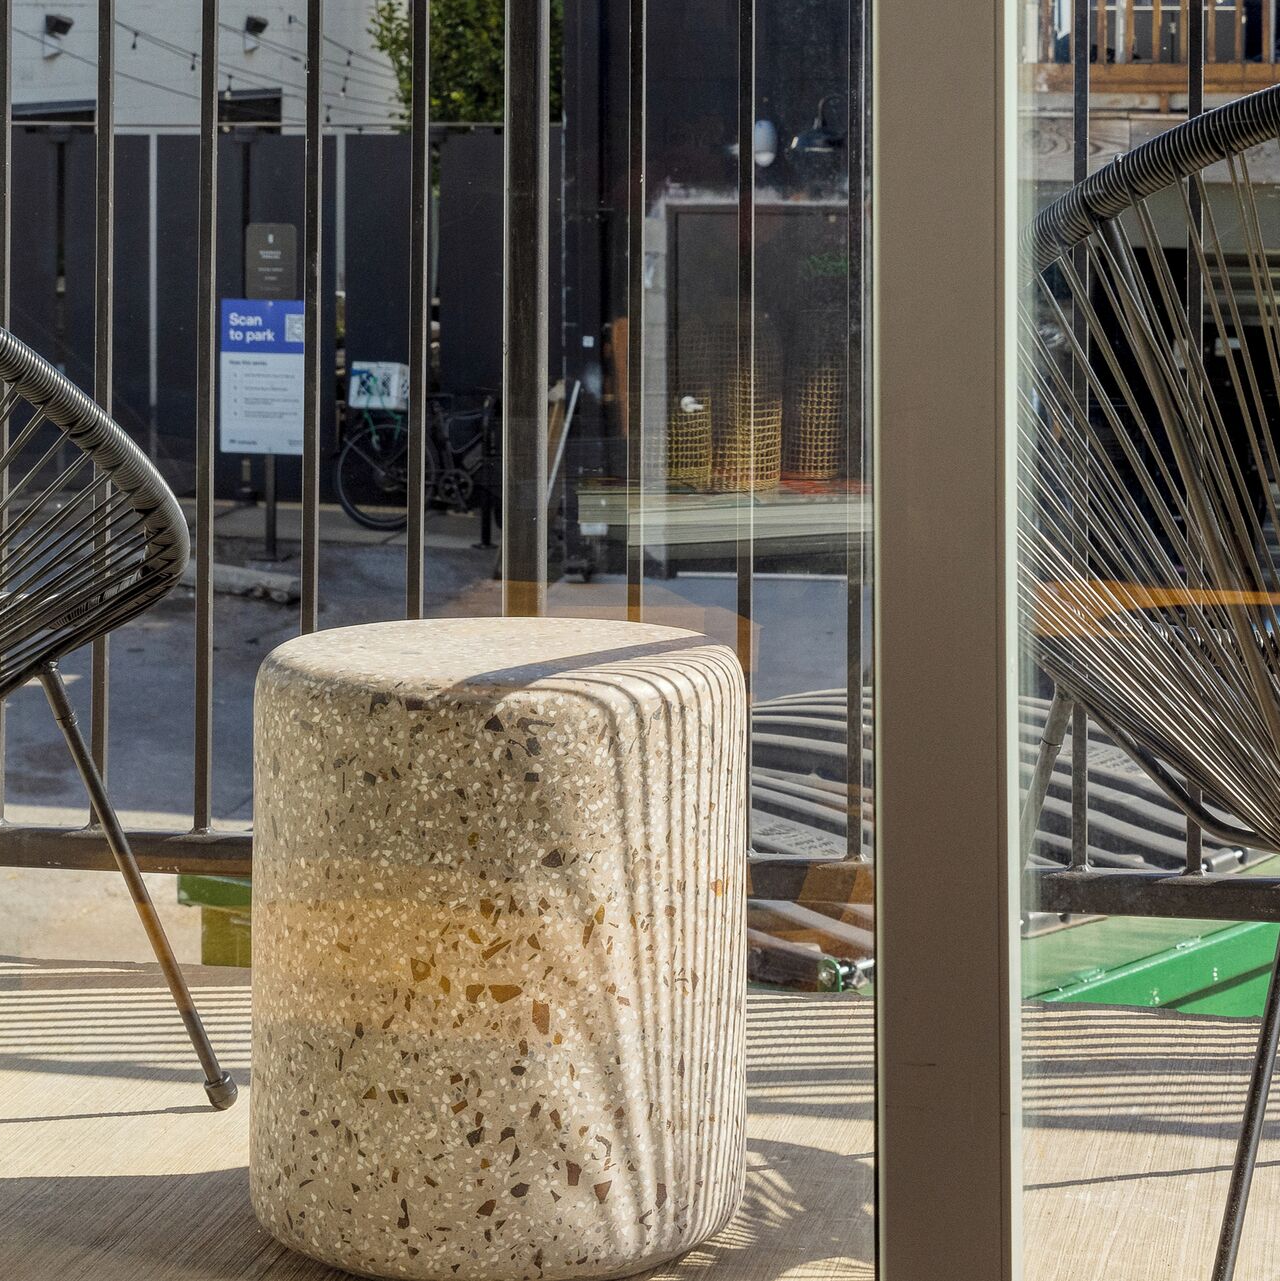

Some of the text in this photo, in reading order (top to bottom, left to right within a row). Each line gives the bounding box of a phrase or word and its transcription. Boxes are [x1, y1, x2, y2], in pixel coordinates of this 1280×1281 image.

[229, 312, 262, 327] Scan
[229, 328, 275, 344] to park
